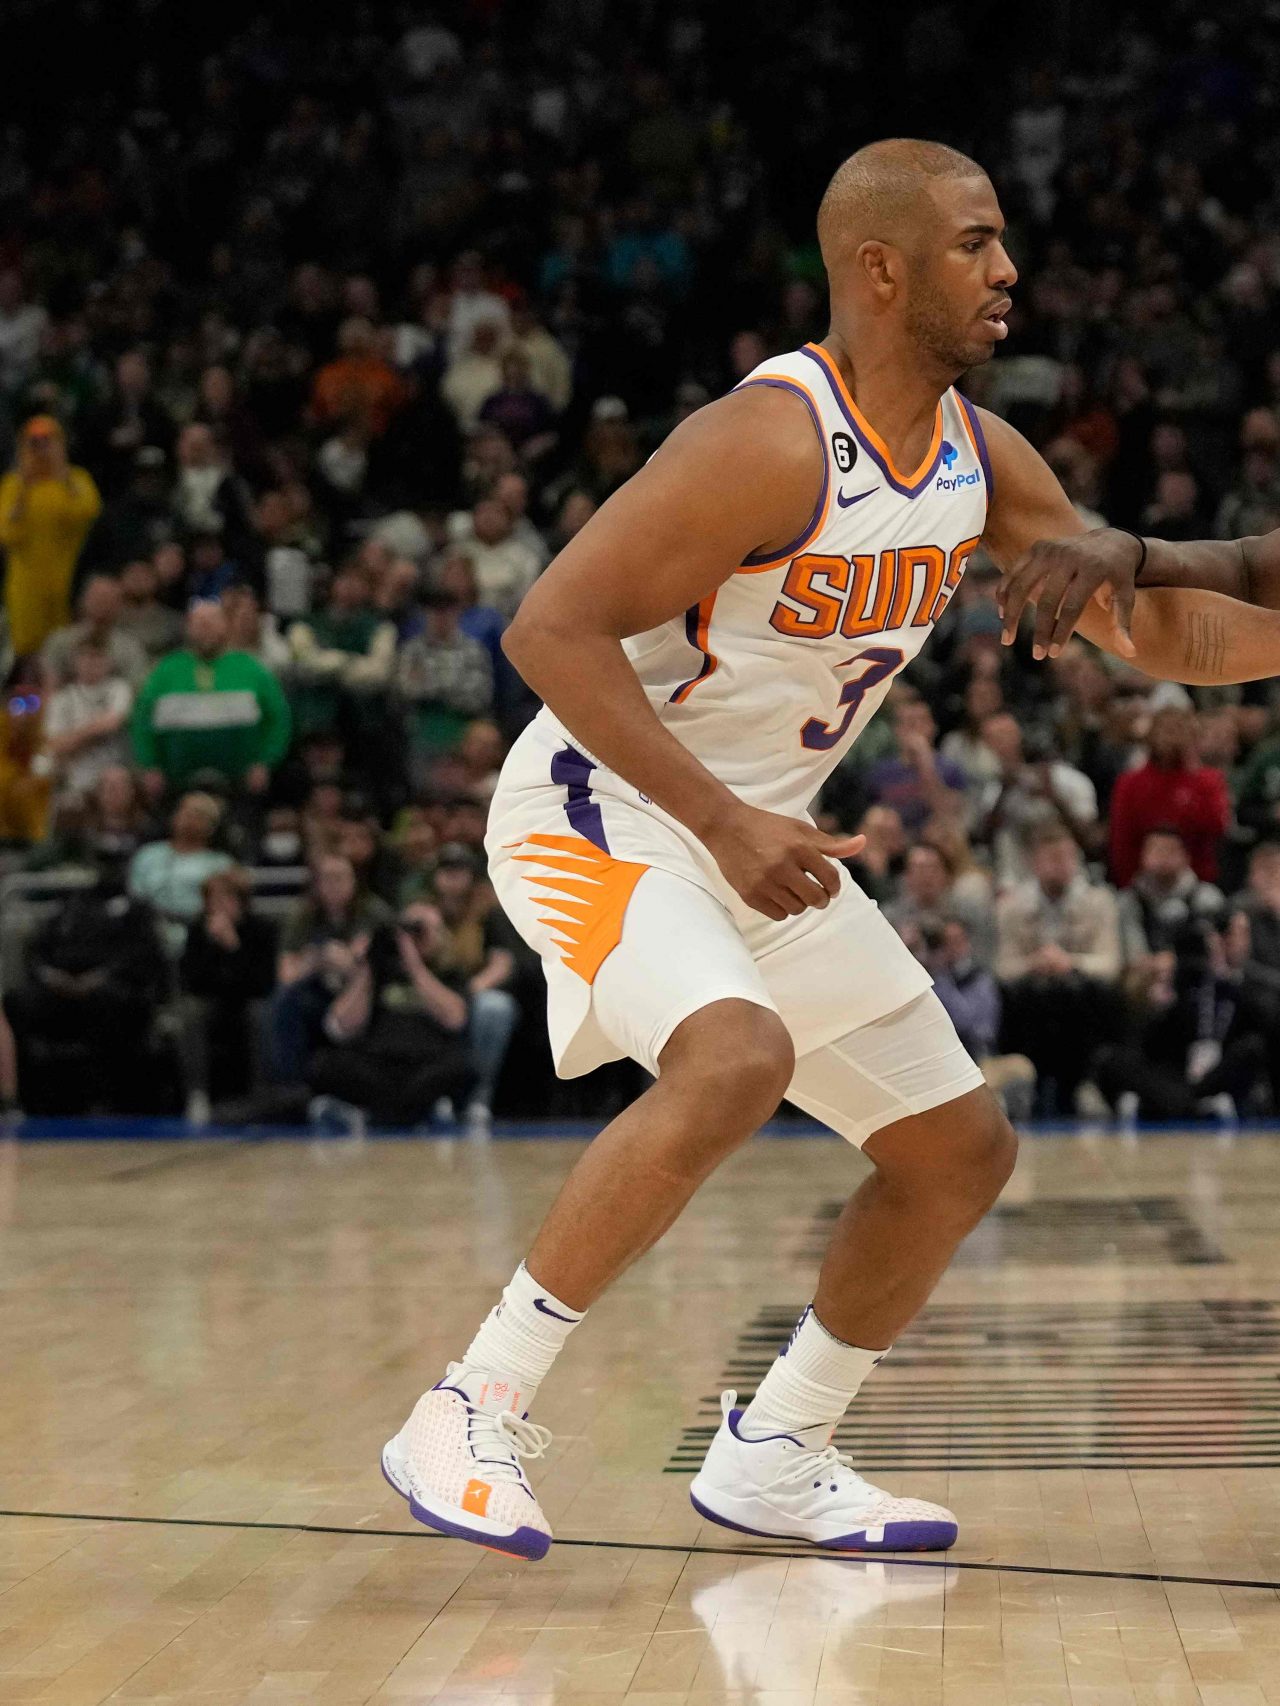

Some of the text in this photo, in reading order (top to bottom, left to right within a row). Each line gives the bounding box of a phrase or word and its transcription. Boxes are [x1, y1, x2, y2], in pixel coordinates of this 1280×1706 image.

[834, 438, 851, 468] 6
[936, 468, 981, 491] PayPal
[800, 647, 904, 751] 3
